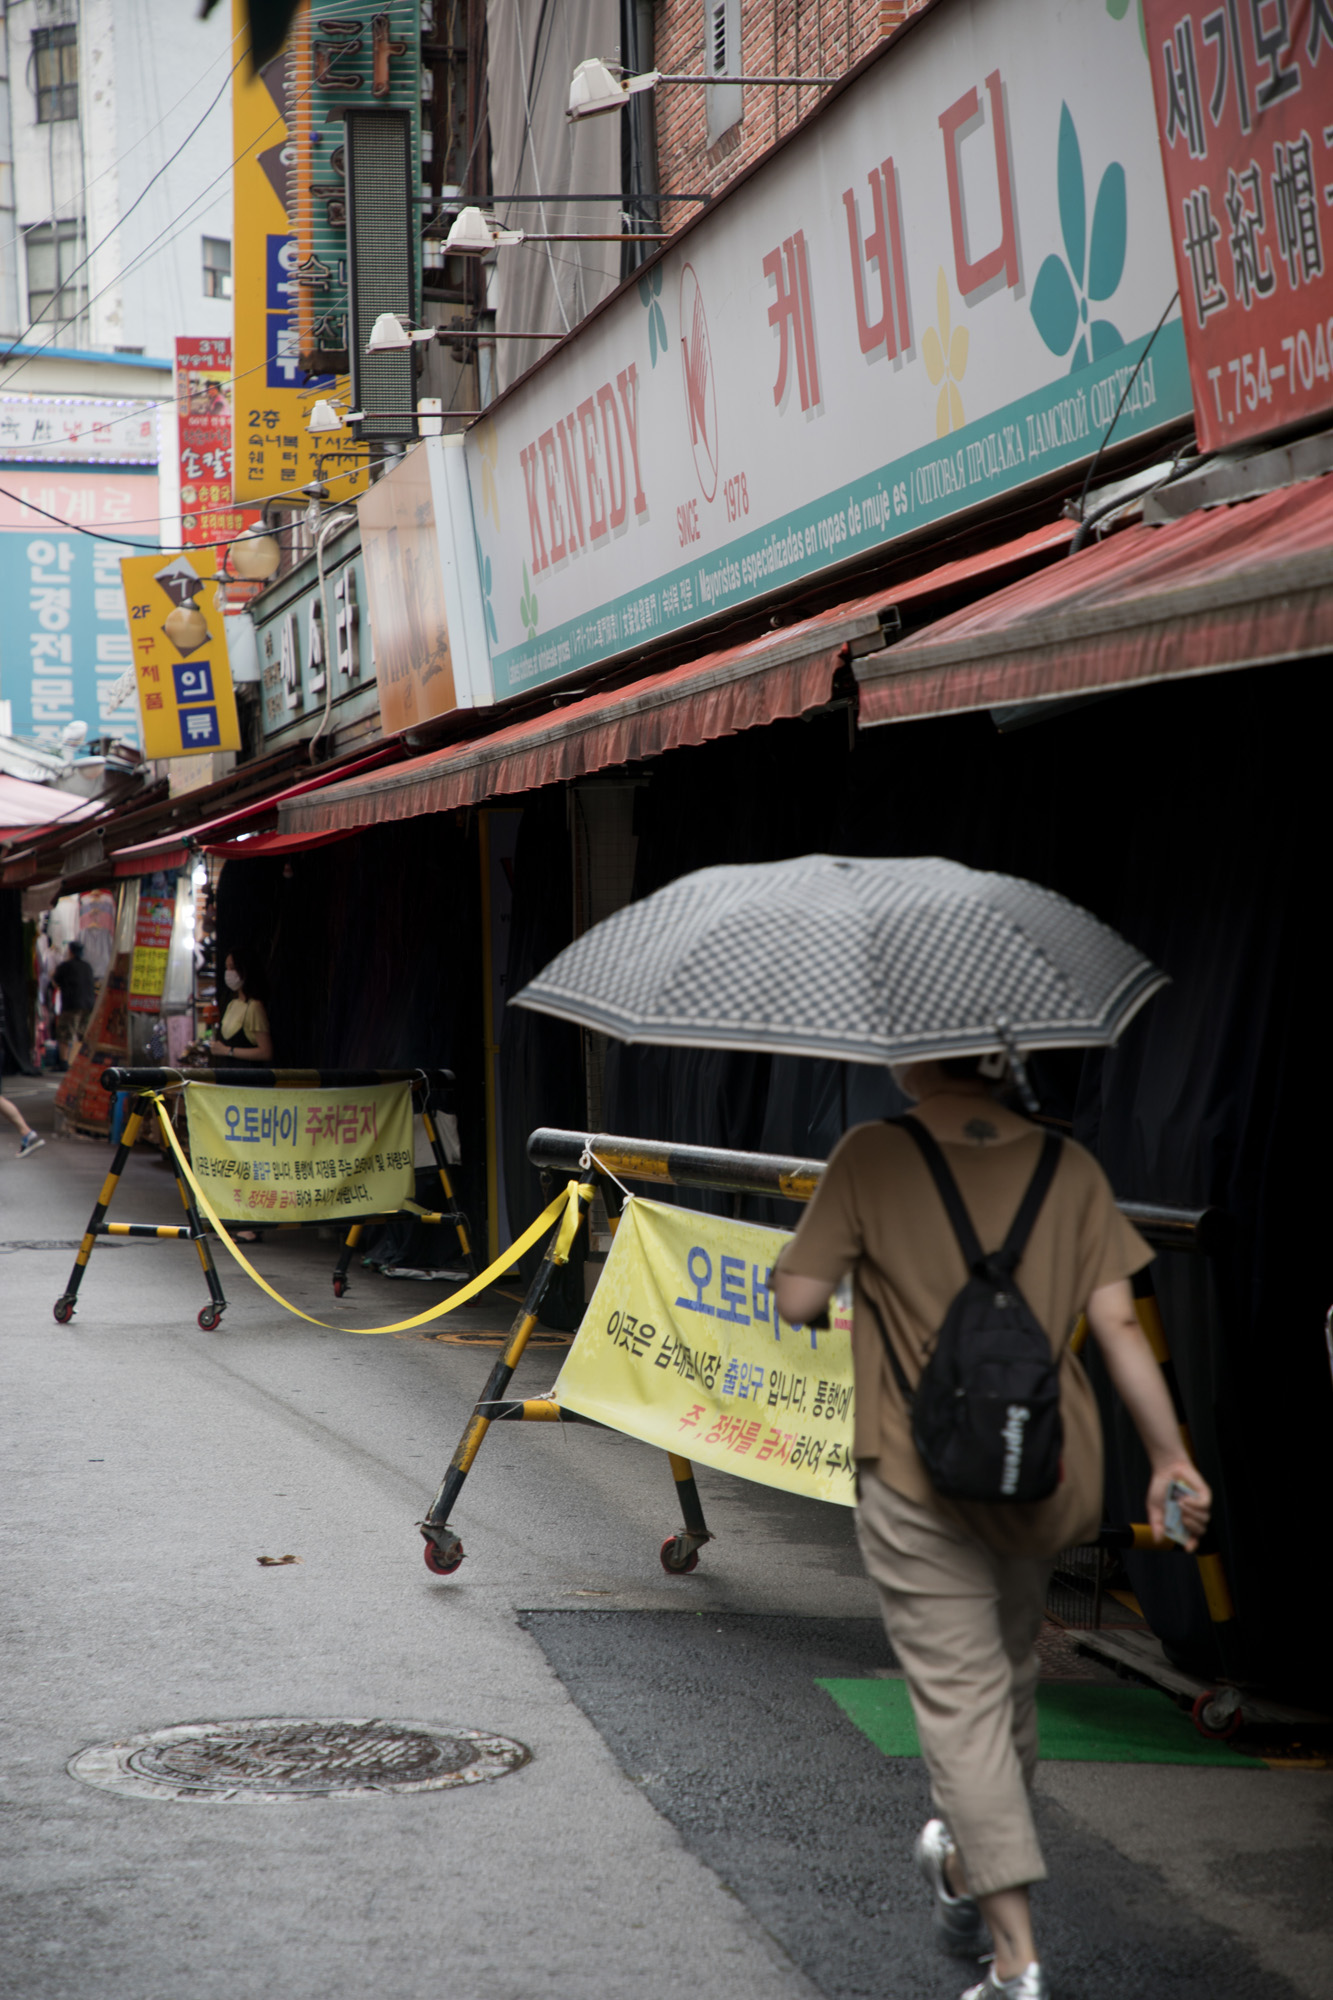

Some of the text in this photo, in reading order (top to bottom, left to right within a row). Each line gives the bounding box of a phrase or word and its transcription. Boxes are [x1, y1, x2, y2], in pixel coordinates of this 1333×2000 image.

[762, 68, 1020, 413] 케네디
[1183, 125, 1333, 329] 世紀帽
[248, 409, 280, 429] 2층
[916, 356, 1157, 505] ОПТОВАЯ ПРОДАЖА ДАМСКОЙ ОДЕЖДЫ
[519, 362, 647, 577] KENEDY
[676, 472, 750, 548] SINCE 1978
[699, 556, 742, 606] Mayoristas
[741, 526, 805, 589] especializadas
[804, 524, 819, 556] en
[817, 510, 848, 554] ropas
[847, 496, 862, 537] de
[131, 604, 151, 619] 2F
[137, 637, 163, 711] 구제품
[181, 670, 213, 740] 의류
[210, 1157, 251, 1180] 남대문시장
[252, 1160, 271, 1181] 출입구
[315, 1159, 337, 1179] 지장을
[338, 1159, 352, 1177] 주는
[375, 1153, 385, 1172] 및
[386, 1149, 411, 1170] 차량의
[225, 1101, 379, 1147] 오토바이 주차금지
[675, 1246, 818, 1350] 오토바
[607, 1310, 656, 1358] 이곳은
[722, 1358, 765, 1402] 출입구
[767, 1370, 807, 1413] 입니다.
[813, 1380, 854, 1423] 통행에
